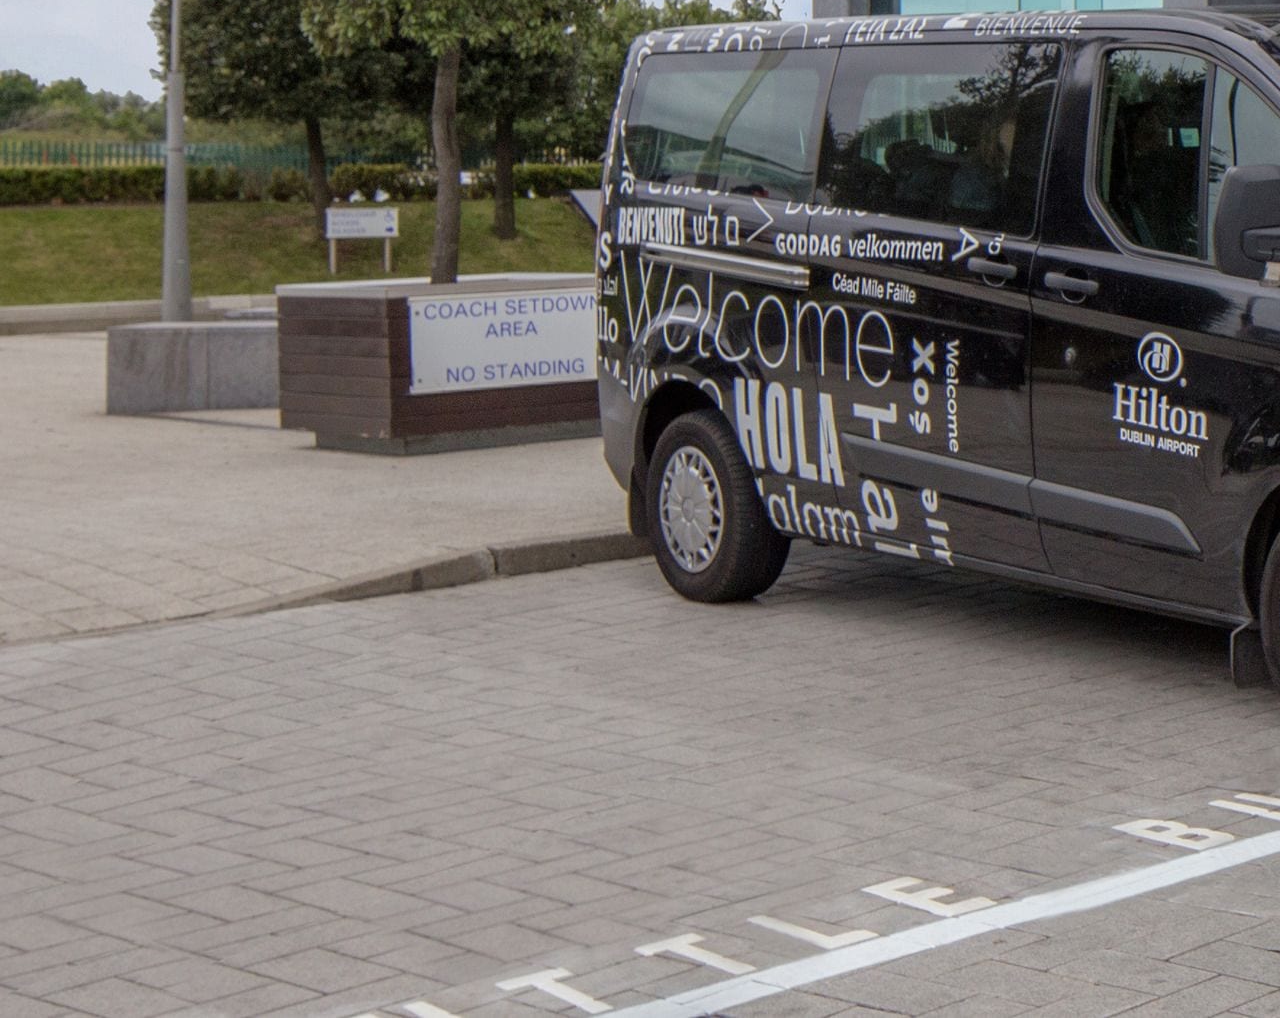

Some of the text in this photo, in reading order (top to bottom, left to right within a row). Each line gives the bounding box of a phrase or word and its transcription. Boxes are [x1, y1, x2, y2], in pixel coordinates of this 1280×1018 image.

[974, 14, 1088, 37] BIENVENUE
[618, 207, 685, 245] BENVENUTI
[775, 233, 944, 261] GODDAG velkommen
[832, 272, 860, 293] Céad
[423, 301, 498, 321] COACH
[619, 249, 895, 388] Welcome
[485, 320, 539, 339] AREA
[446, 358, 586, 383] NO STANDING
[945, 338, 960, 454] Welcome
[1113, 382, 1209, 441] Hilton
[734, 376, 846, 488] HOLA
[1120, 428, 1200, 458] DUBLIN AIRPORT
